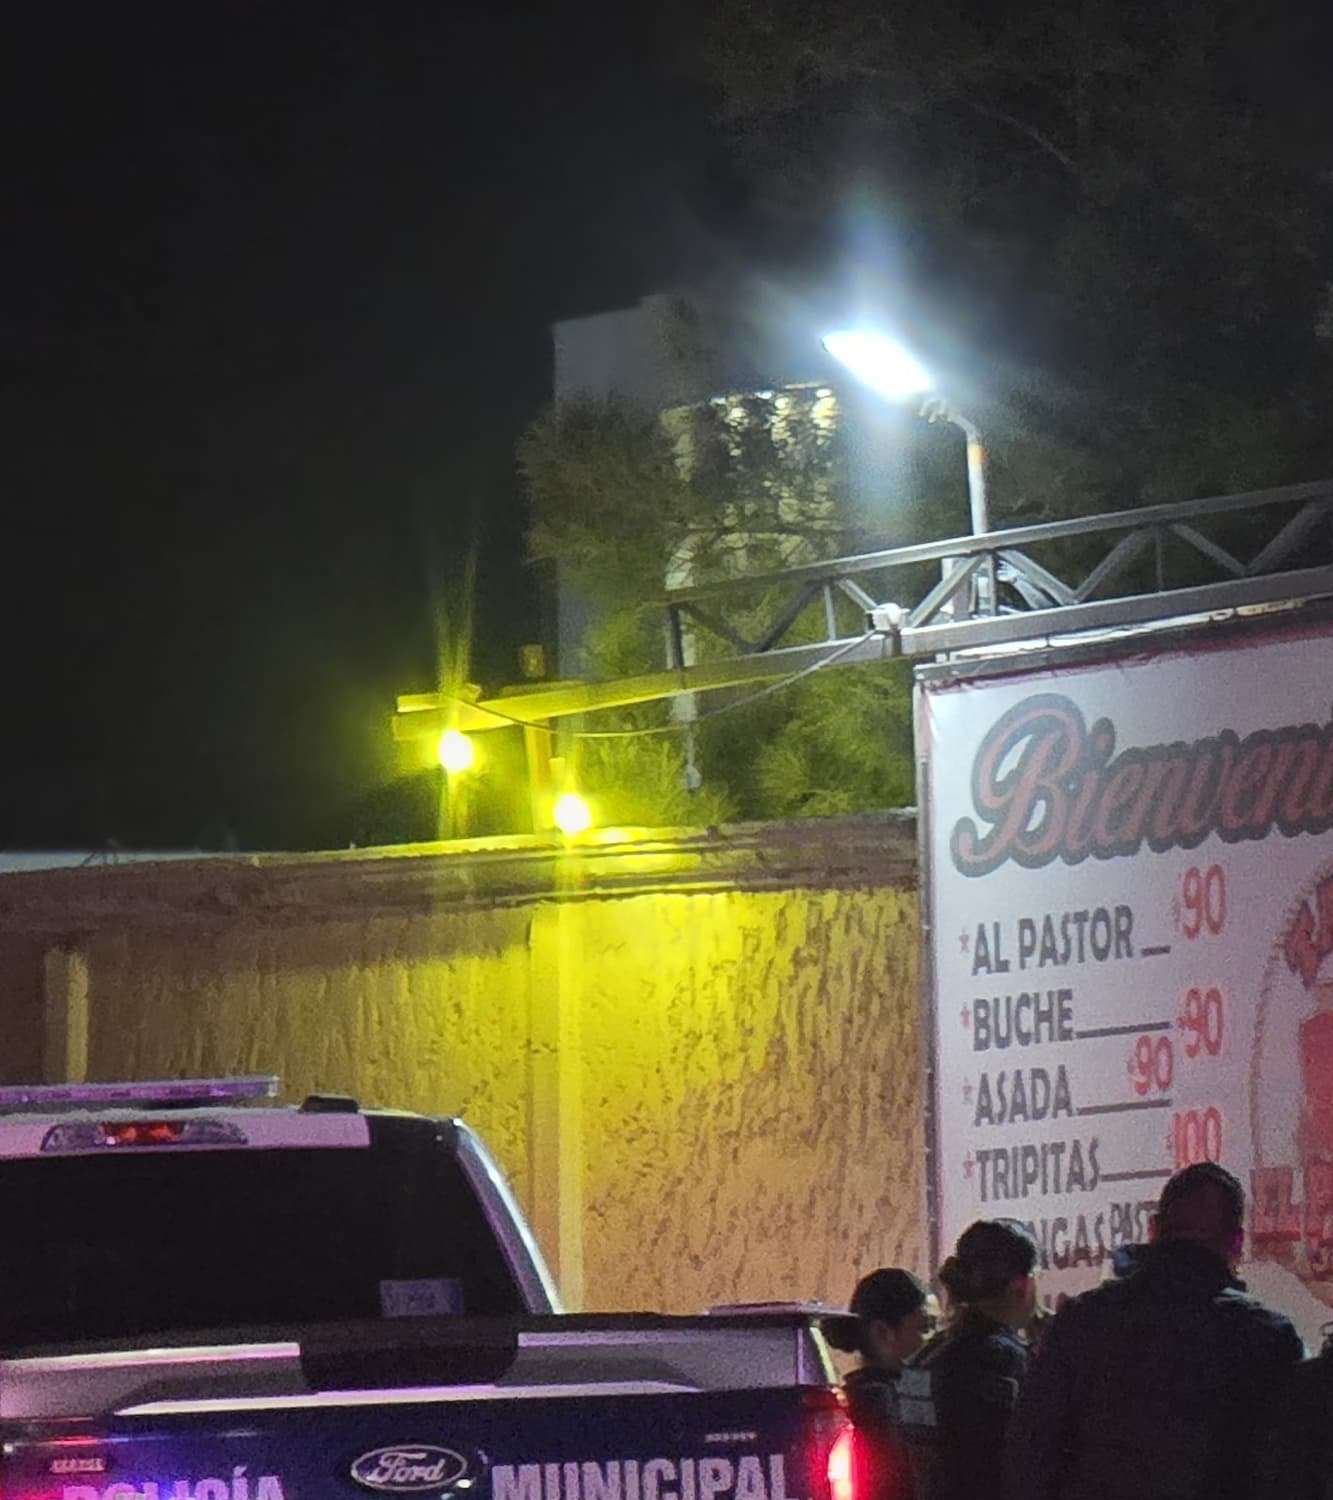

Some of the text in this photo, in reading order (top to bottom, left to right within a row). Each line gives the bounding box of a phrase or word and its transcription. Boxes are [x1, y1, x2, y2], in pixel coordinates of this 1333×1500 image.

[972, 922, 1010, 976] AL
[1017, 904, 1134, 970] PASTOR
[973, 988, 1073, 1051] BUCHE
[975, 1064, 1073, 1127] ASADA
[975, 1138, 1099, 1202] TRIPITAS
[366, 1451, 446, 1484] Ford
